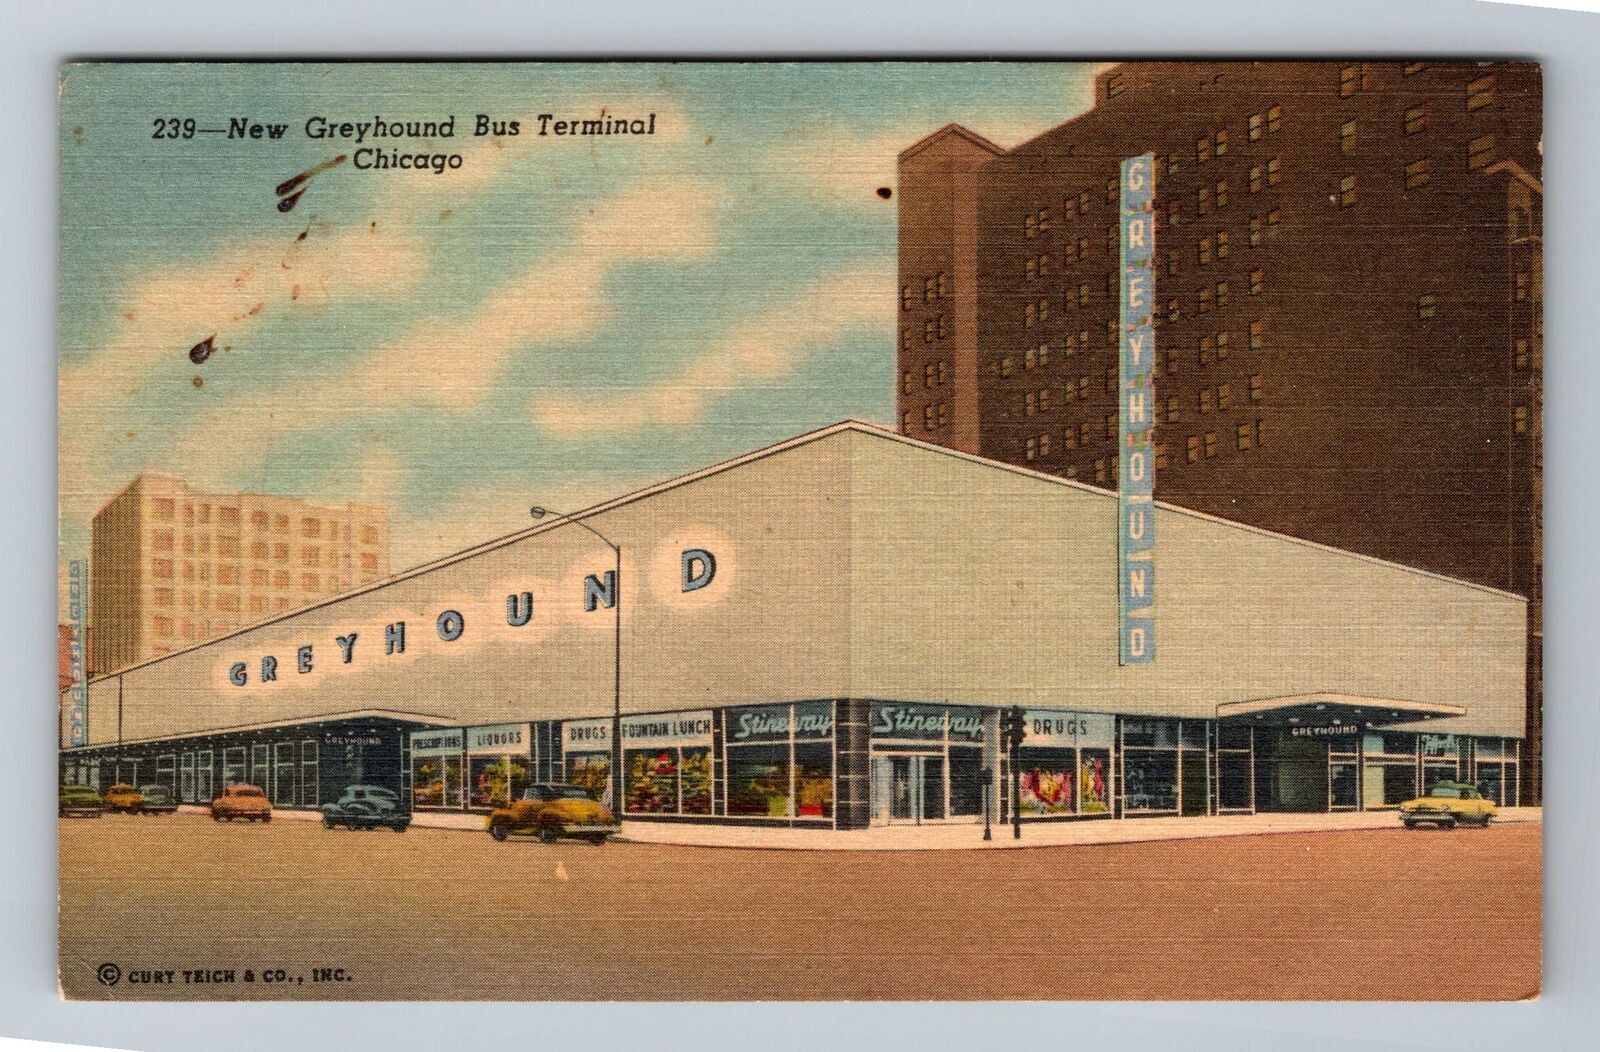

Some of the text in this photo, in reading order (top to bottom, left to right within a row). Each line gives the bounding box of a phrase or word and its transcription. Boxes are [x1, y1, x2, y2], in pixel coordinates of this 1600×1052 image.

[1127, 161, 1145, 657] GREYHOUND
[229, 547, 718, 687] GREYHOUND
[570, 724, 607, 741] DRUGS
[621, 719, 713, 739] FOUNTAIN LUNCH
[734, 713, 833, 740] Stineway
[873, 706, 985, 739] Stineway
[1033, 718, 1088, 736] DRUGS
[1291, 725, 1359, 737] GREYHOUND
[476, 731, 522, 747] LIQUORS
